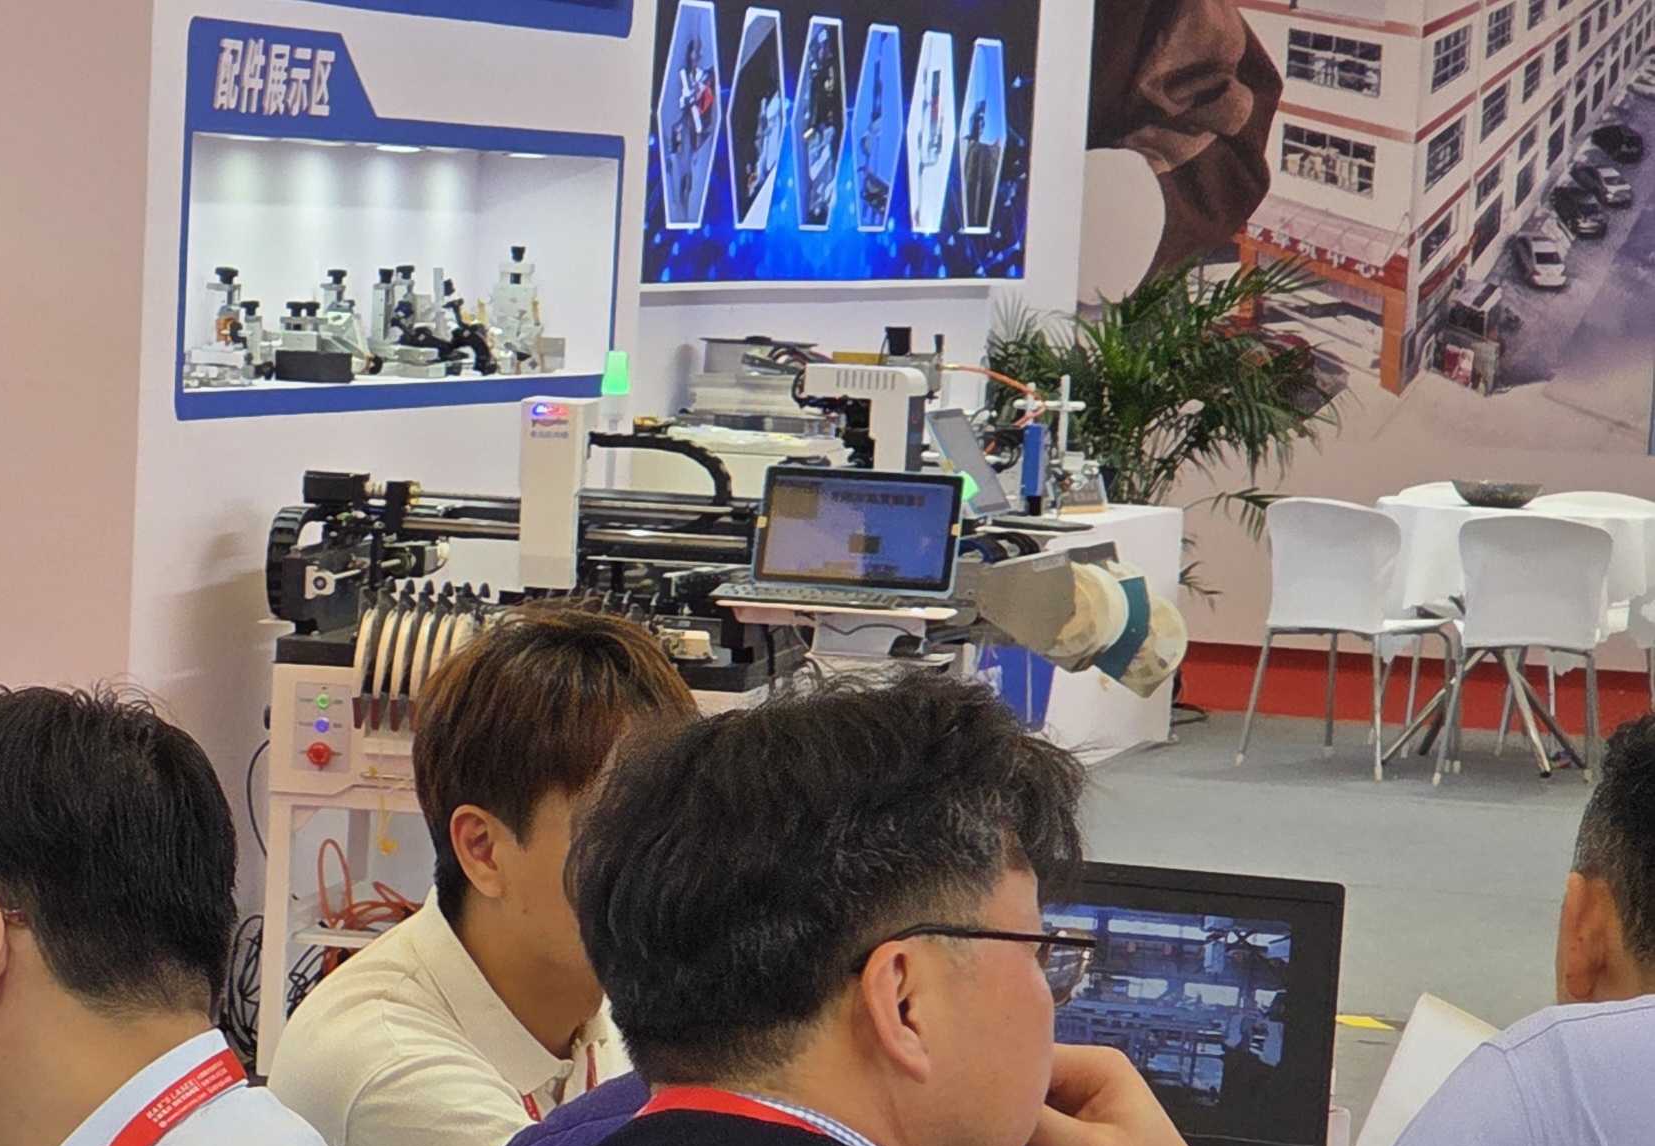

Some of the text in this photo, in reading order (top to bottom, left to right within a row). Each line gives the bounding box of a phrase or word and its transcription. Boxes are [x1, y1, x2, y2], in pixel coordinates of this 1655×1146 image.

[213, 37, 336, 117] 配件展示区
